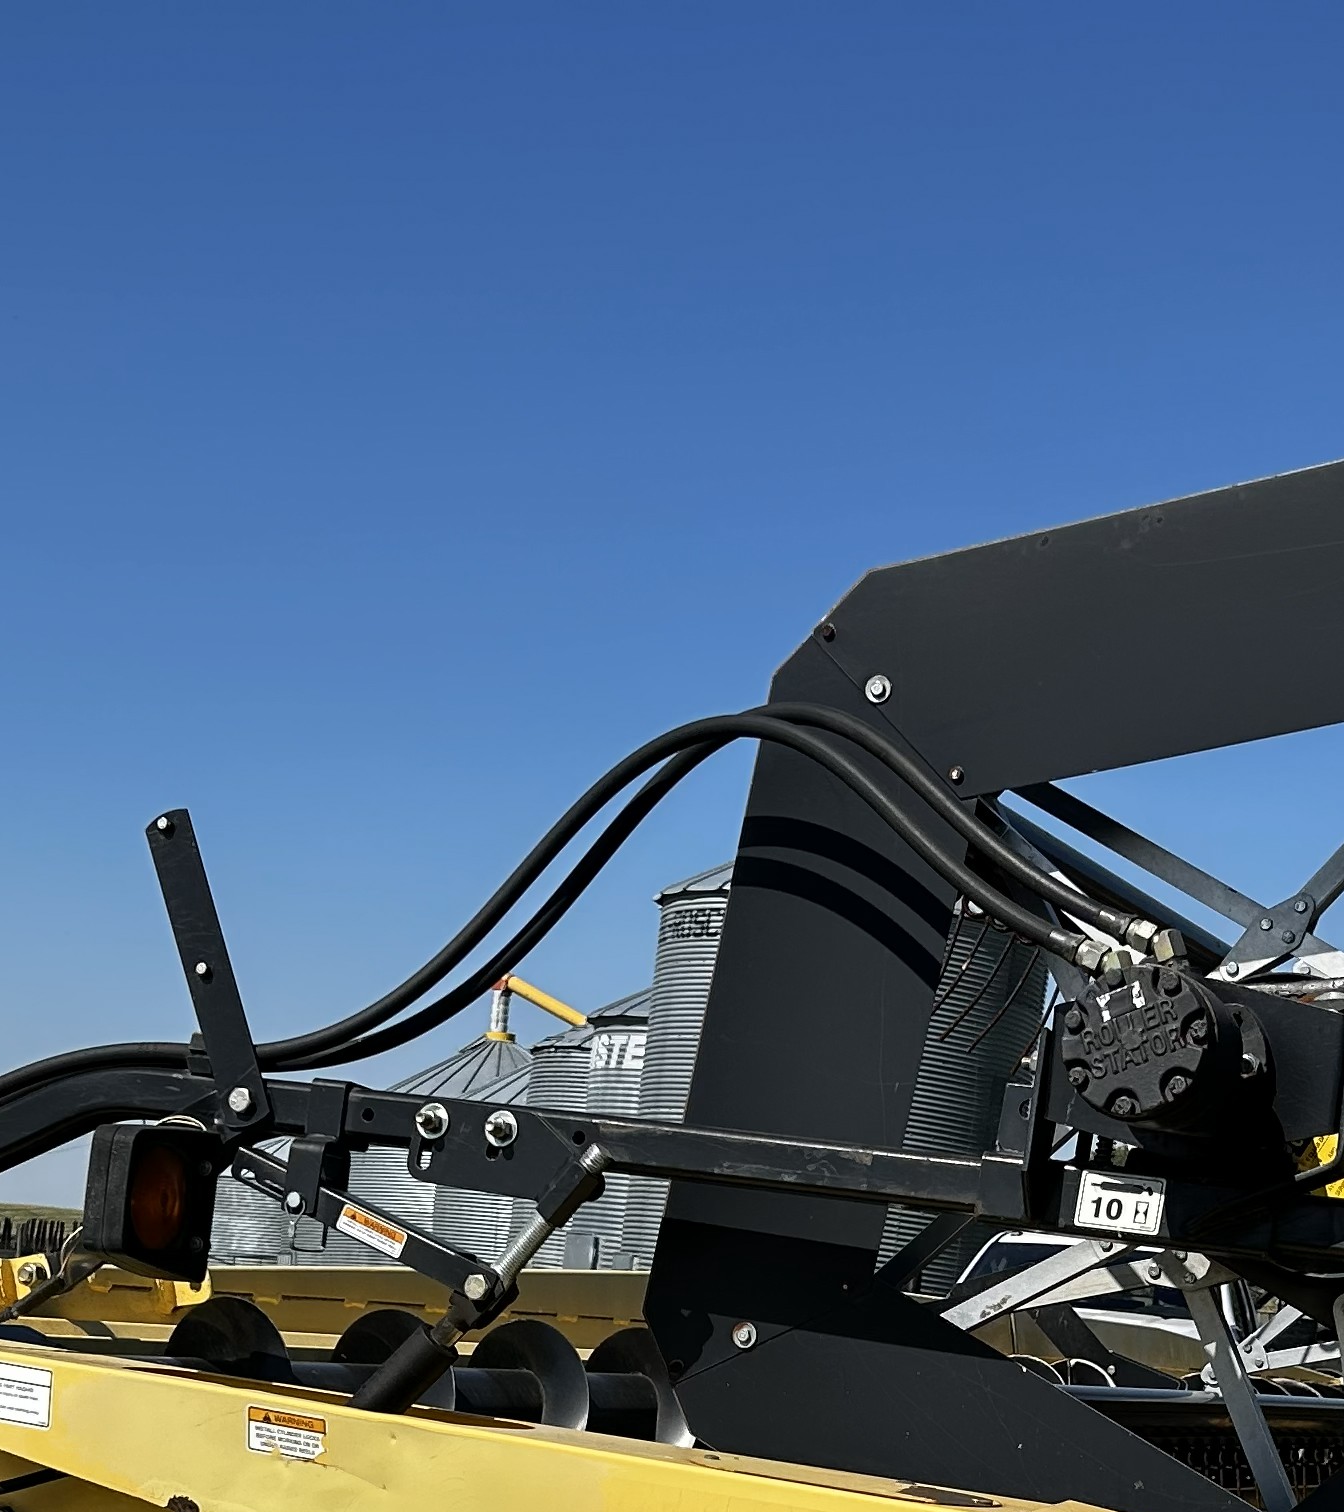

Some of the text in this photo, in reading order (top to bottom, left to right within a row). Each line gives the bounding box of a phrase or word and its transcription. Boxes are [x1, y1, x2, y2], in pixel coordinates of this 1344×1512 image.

[1081, 1000, 1178, 1055] ROLLER
[1090, 1027, 1186, 1079] STATOR
[1091, 1197, 1123, 1220] 10
[274, 1414, 314, 1428] WARNING
